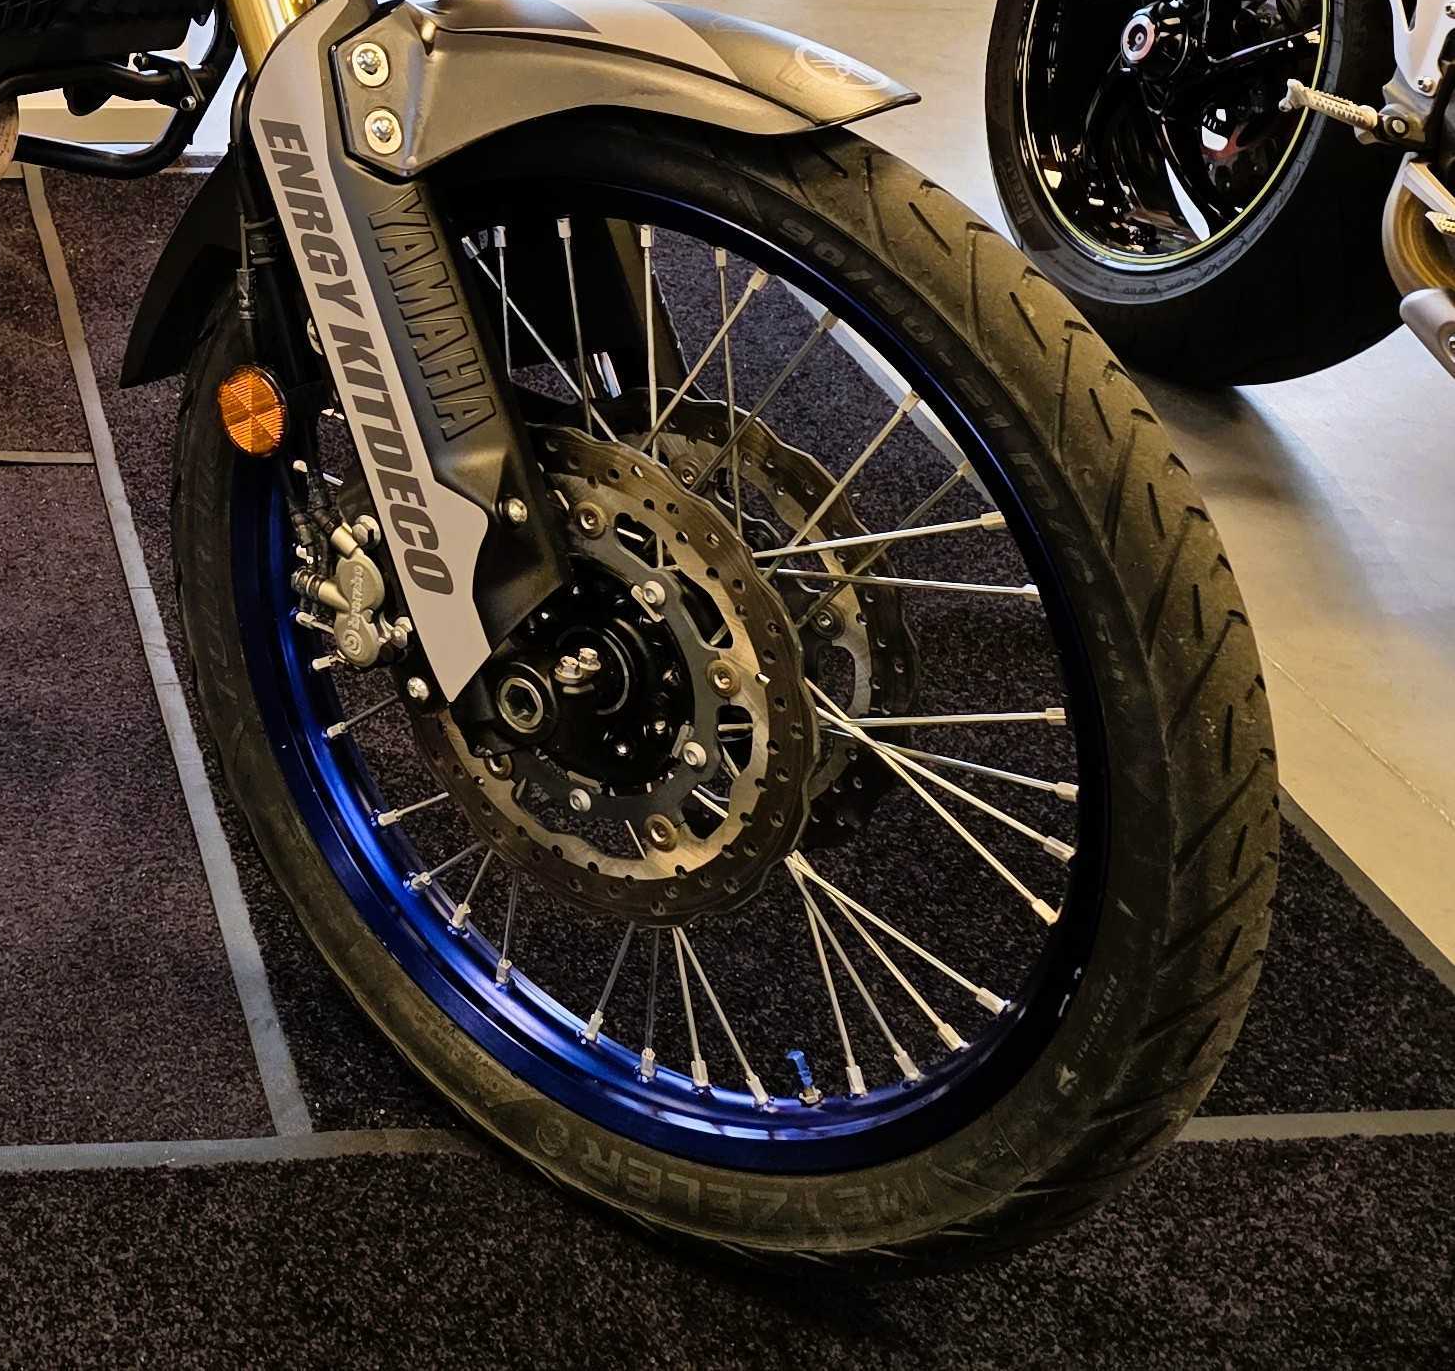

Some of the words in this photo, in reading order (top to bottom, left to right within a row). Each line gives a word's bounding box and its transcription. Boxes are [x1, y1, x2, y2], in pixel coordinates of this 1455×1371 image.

[260, 119, 366, 319] ENRGY
[328, 323, 454, 597] KITDECO
[369, 188, 498, 444] YAMAHA
